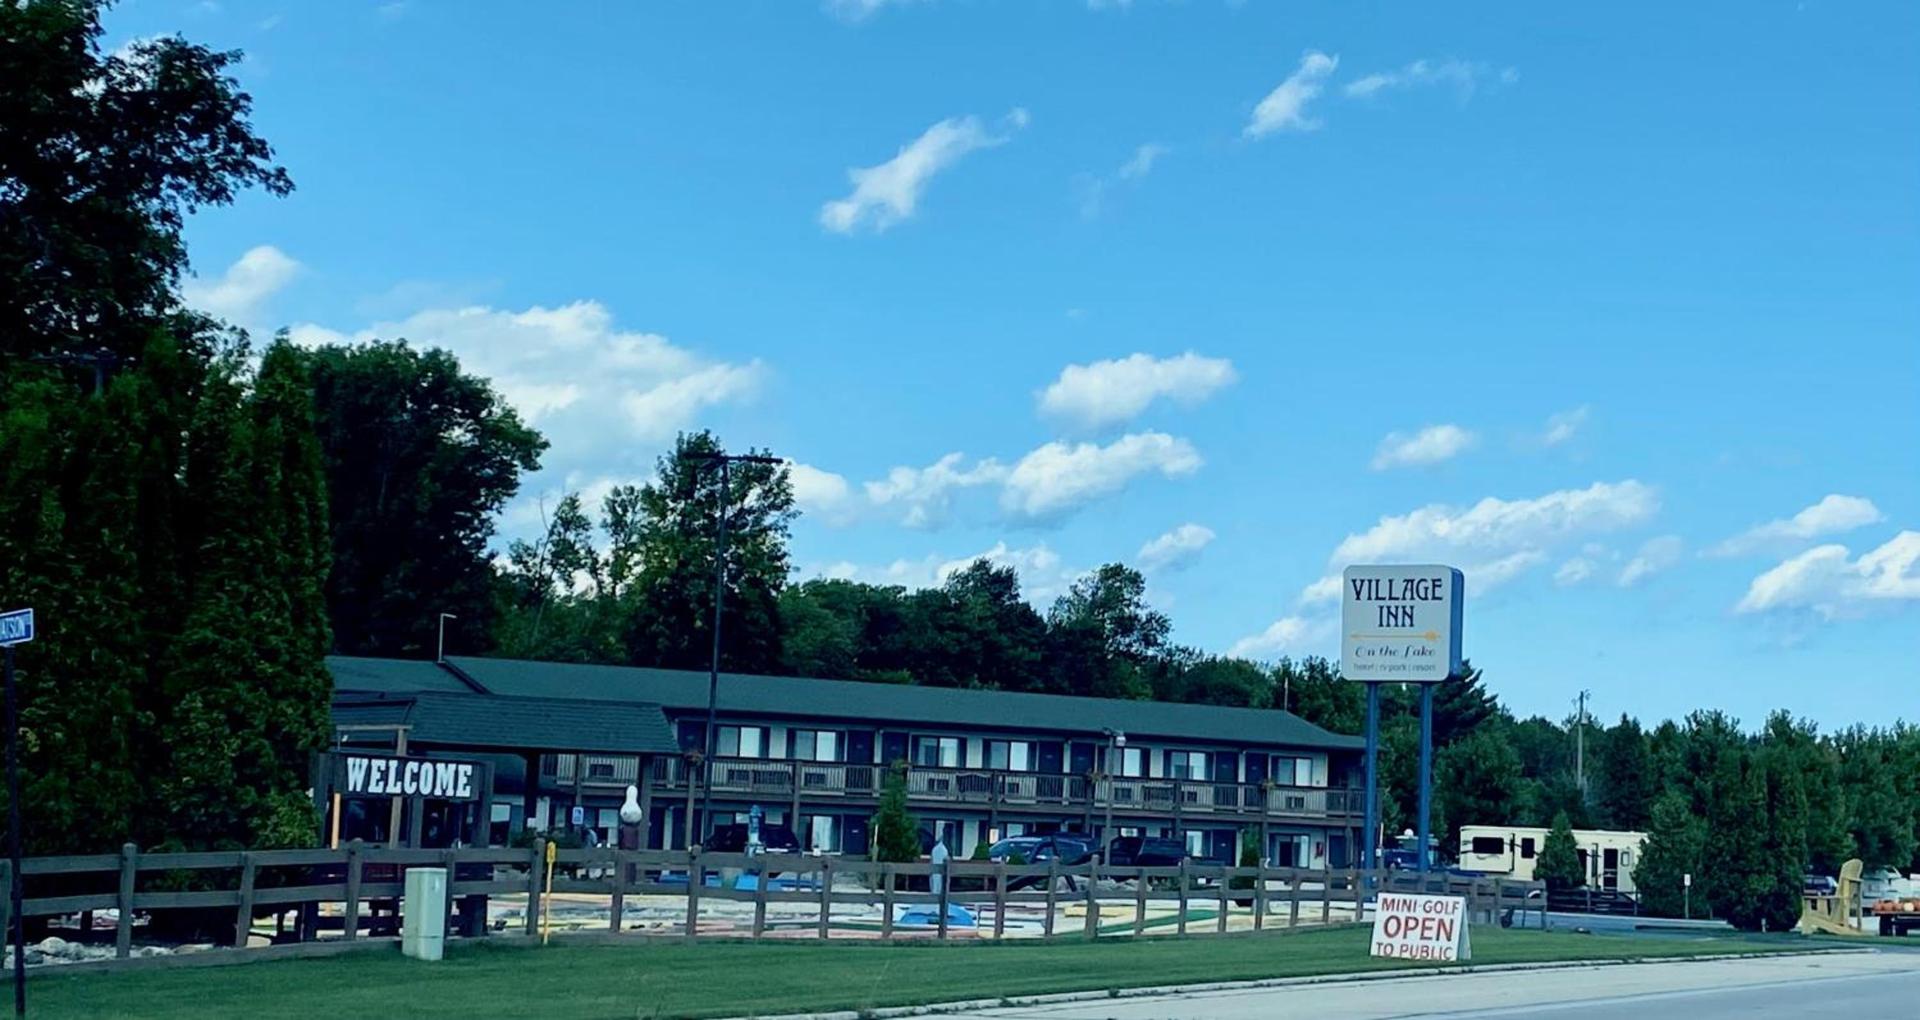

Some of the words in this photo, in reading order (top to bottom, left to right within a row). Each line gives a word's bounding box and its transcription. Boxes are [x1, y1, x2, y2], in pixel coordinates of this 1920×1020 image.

[1351, 578, 1443, 601] VILLAGE
[1378, 605, 1415, 628] INN
[1379, 645, 1399, 657] the
[346, 757, 473, 797] WELCOME
[1383, 915, 1454, 942] OPEN
[1376, 942, 1395, 957] TO
[1399, 944, 1453, 960] PUBLIC
